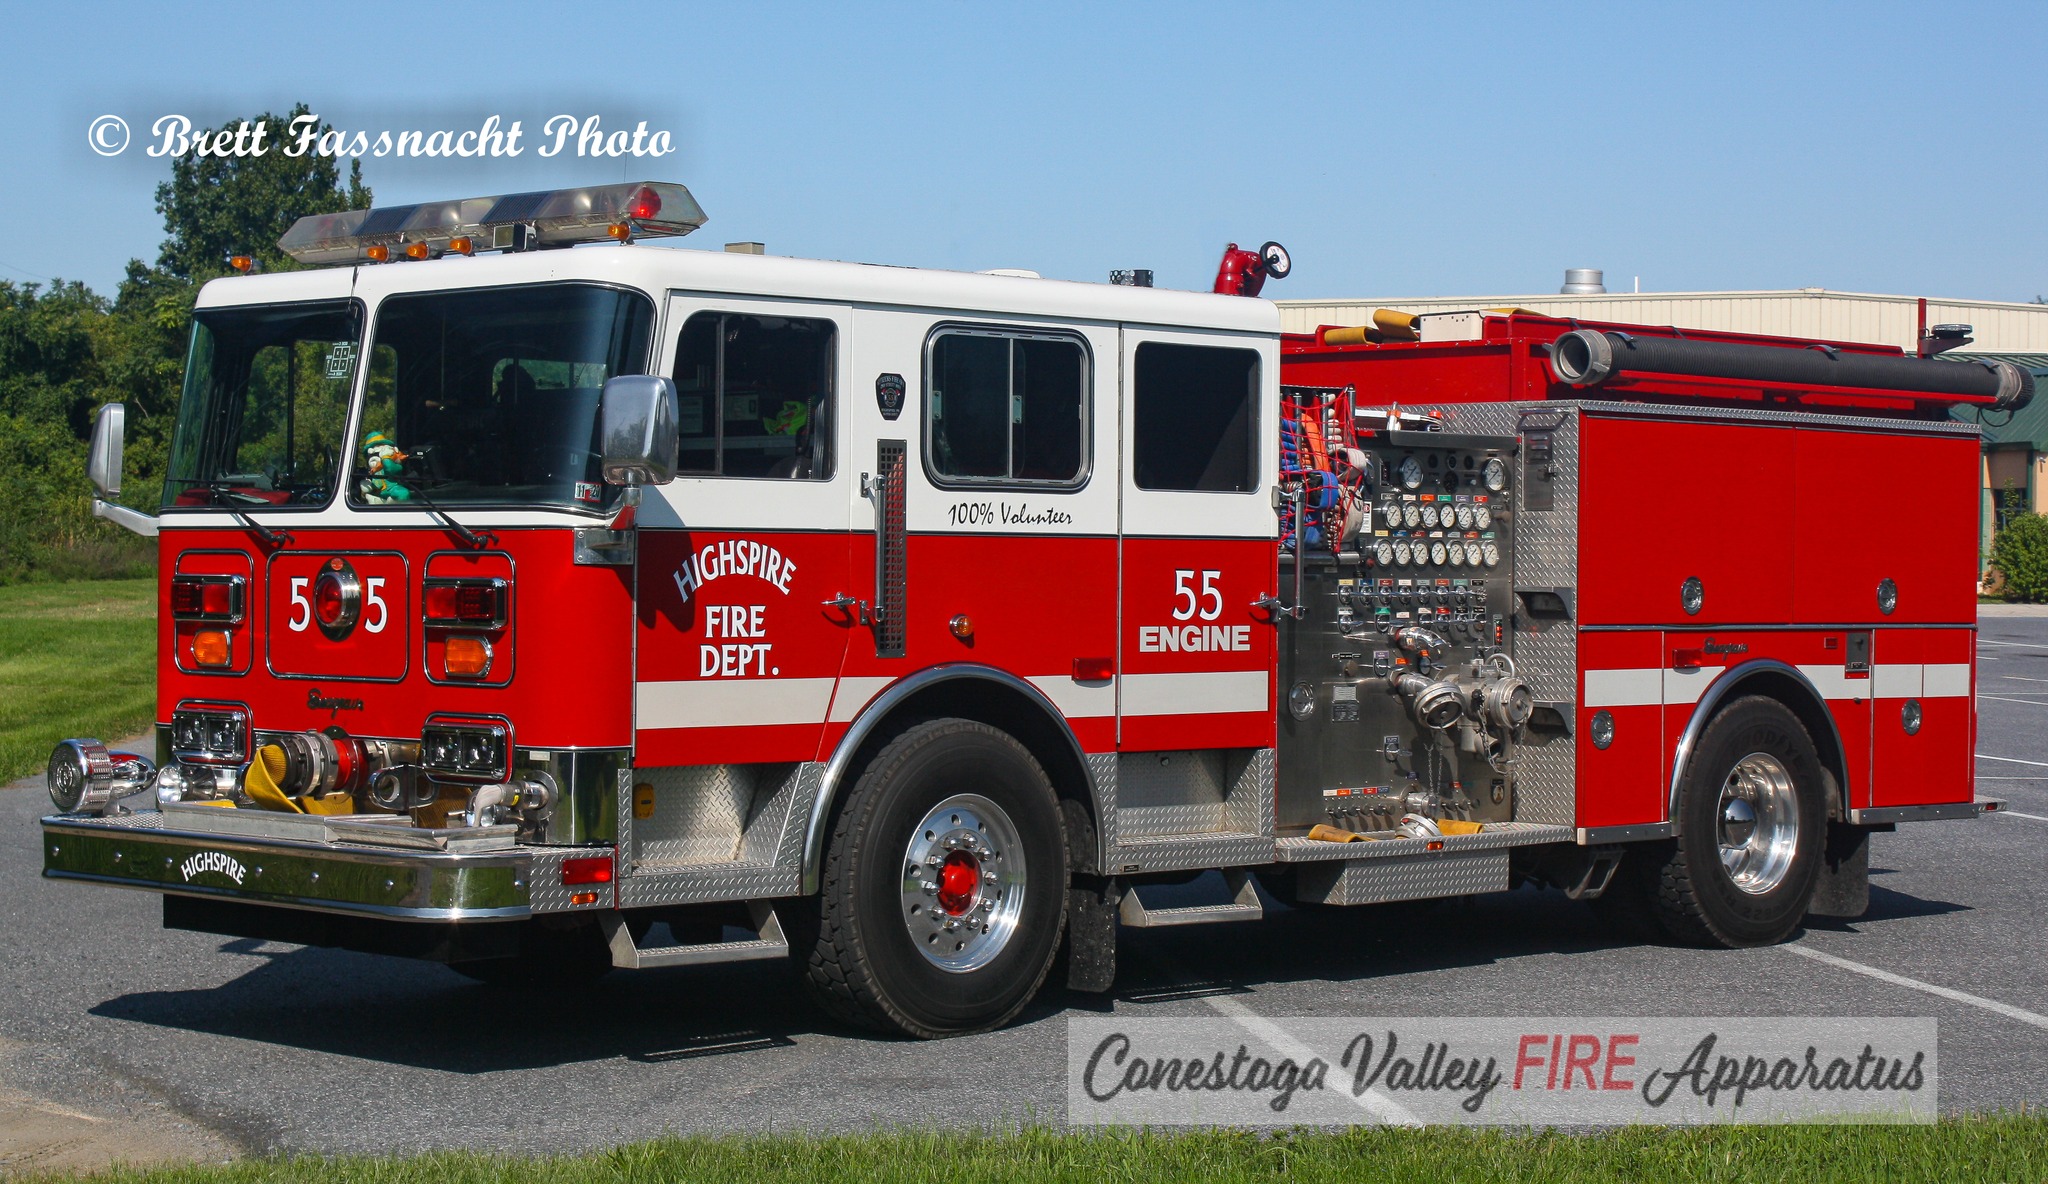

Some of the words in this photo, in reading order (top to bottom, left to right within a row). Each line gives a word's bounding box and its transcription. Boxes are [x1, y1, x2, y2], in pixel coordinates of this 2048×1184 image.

[948, 502, 994, 526] 100%
[1001, 501, 1073, 525] Volunteer
[673, 539, 797, 603] HIGHSPIRE
[288, 577, 311, 632] 5
[364, 577, 388, 633] 5
[1172, 570, 1223, 621] 55
[705, 605, 766, 638] FIRE
[1139, 625, 1251, 653] ENGINE
[699, 643, 780, 677] DEPT.
[180, 851, 247, 885] HIGHSPIRE
